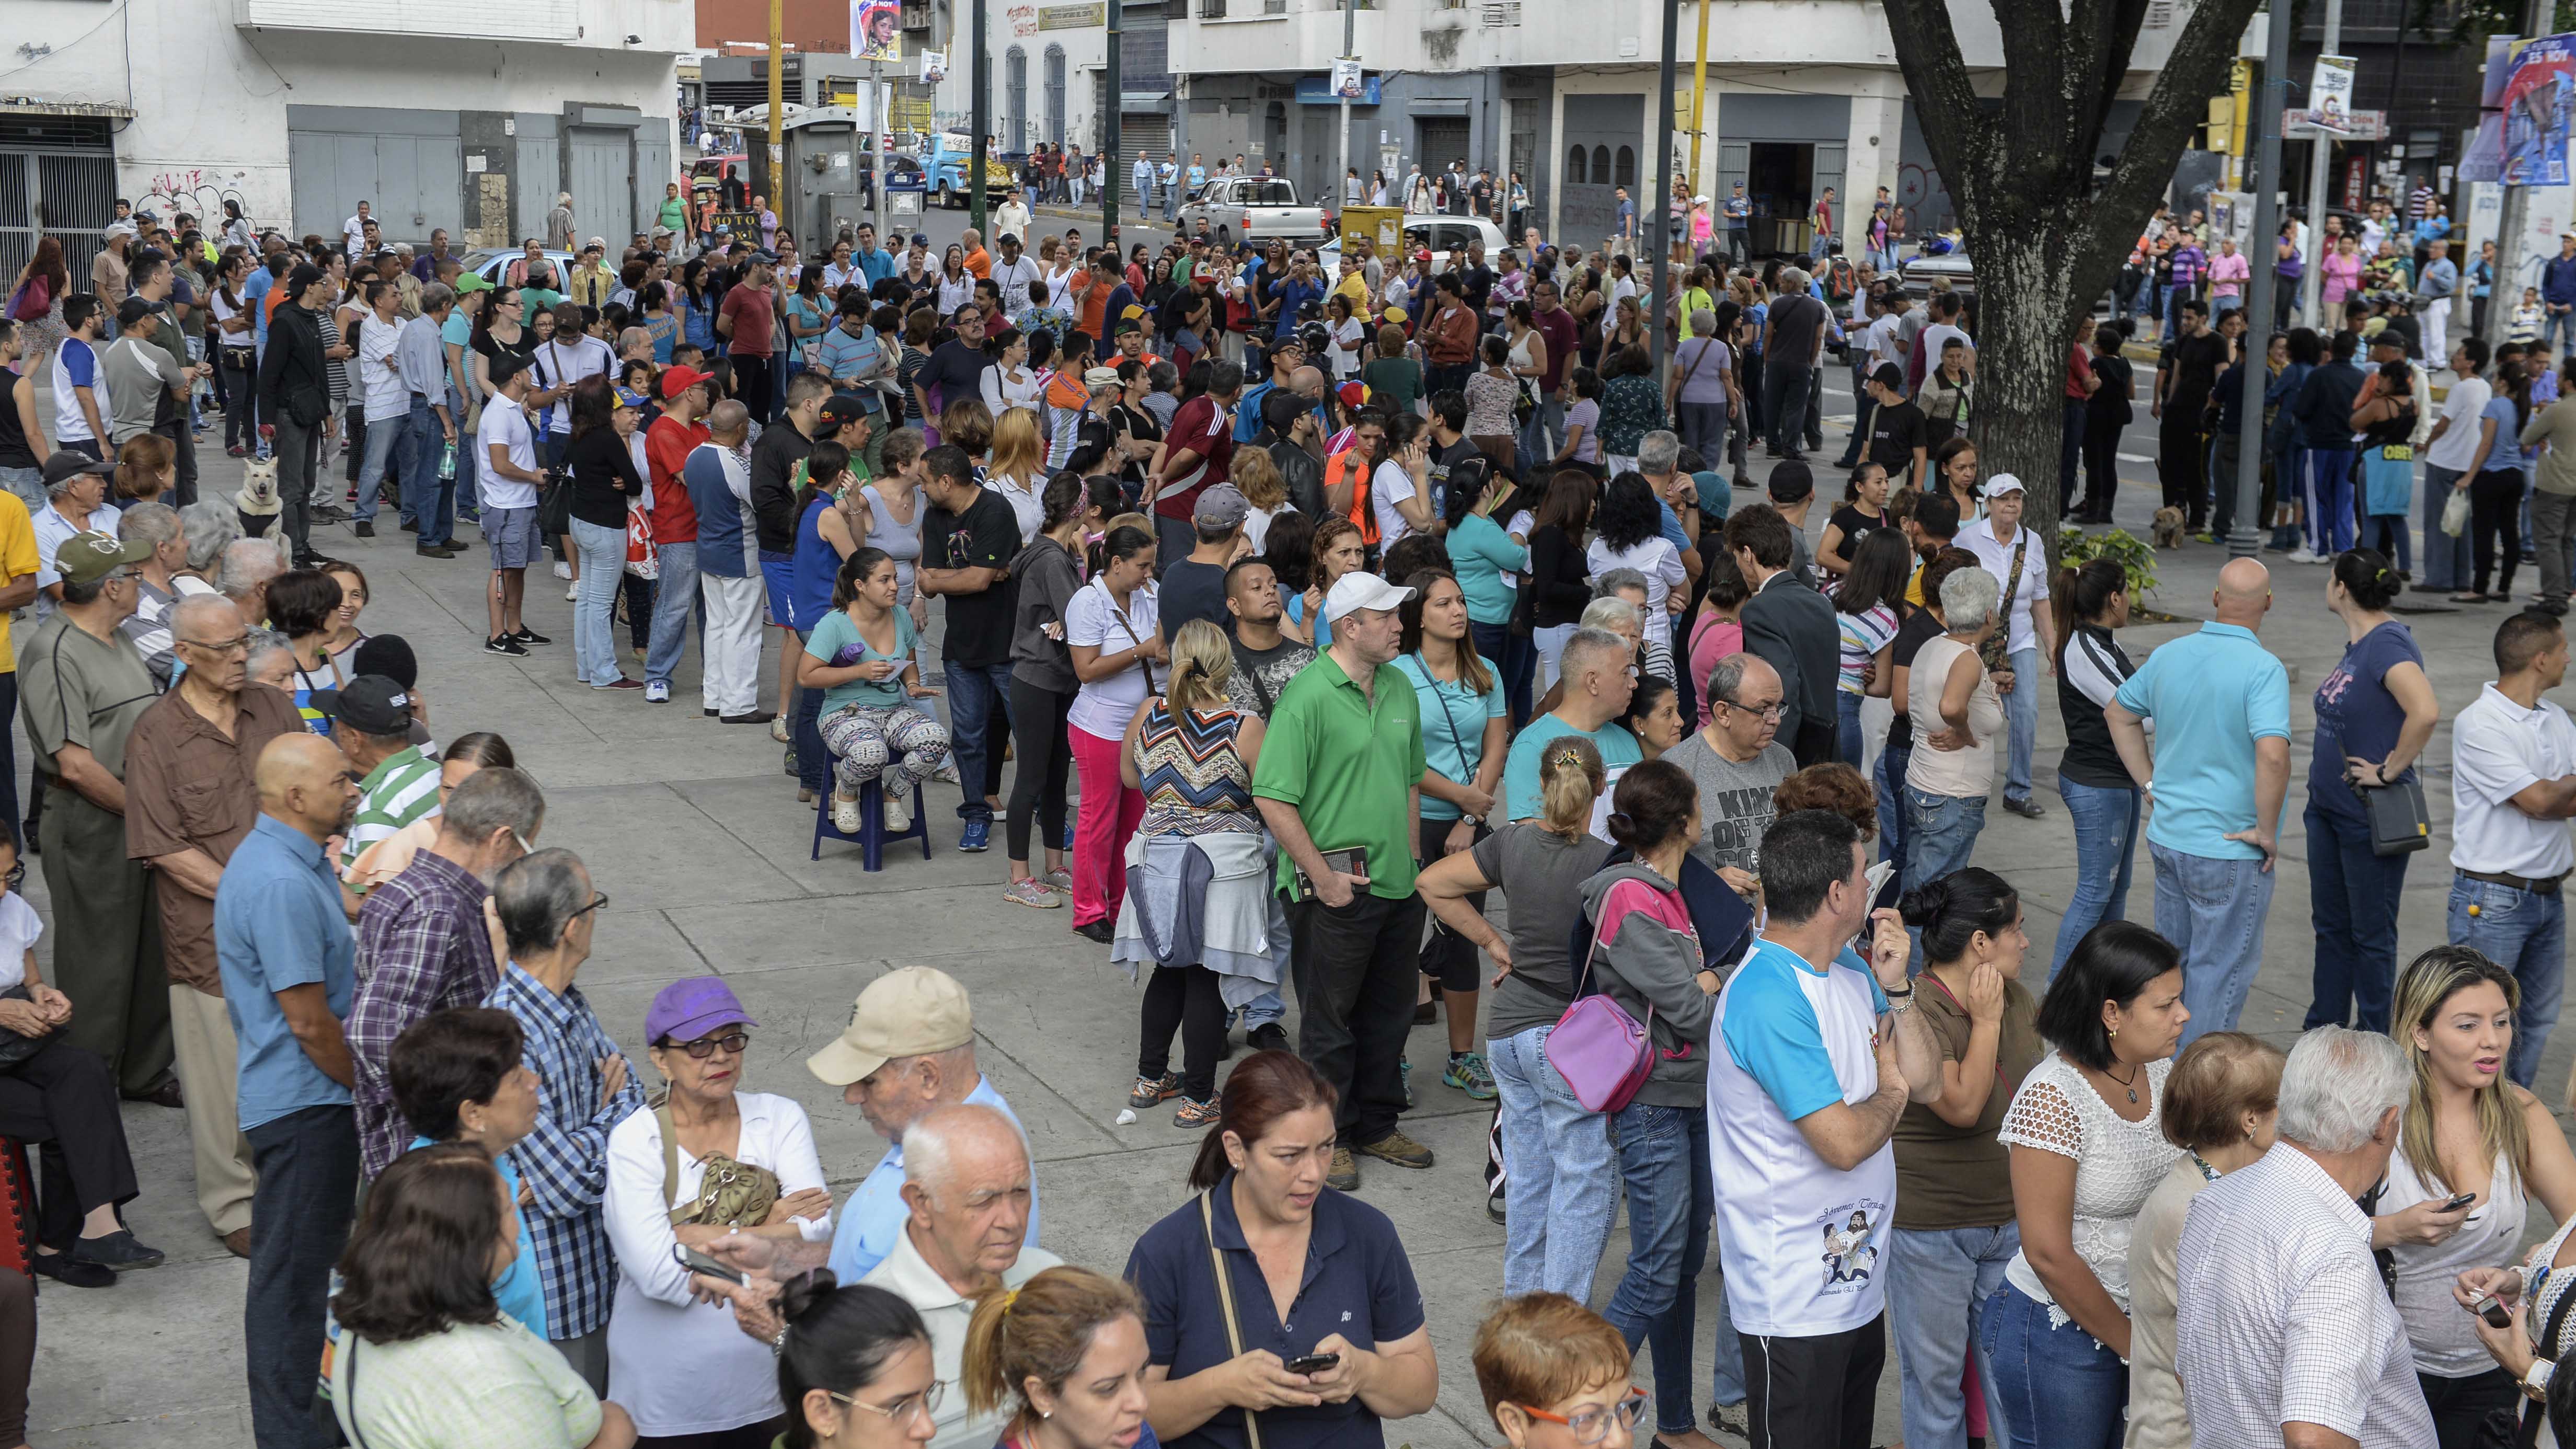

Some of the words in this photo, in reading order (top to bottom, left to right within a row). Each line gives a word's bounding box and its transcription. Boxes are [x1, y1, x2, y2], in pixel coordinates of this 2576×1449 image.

[2528, 51, 2543, 64] ES
[2546, 50, 2570, 62] HOY
[711, 215, 755, 226] MOTO
[1712, 818, 1751, 850] OF
[1816, 1203, 1855, 1223] Jóvenes
